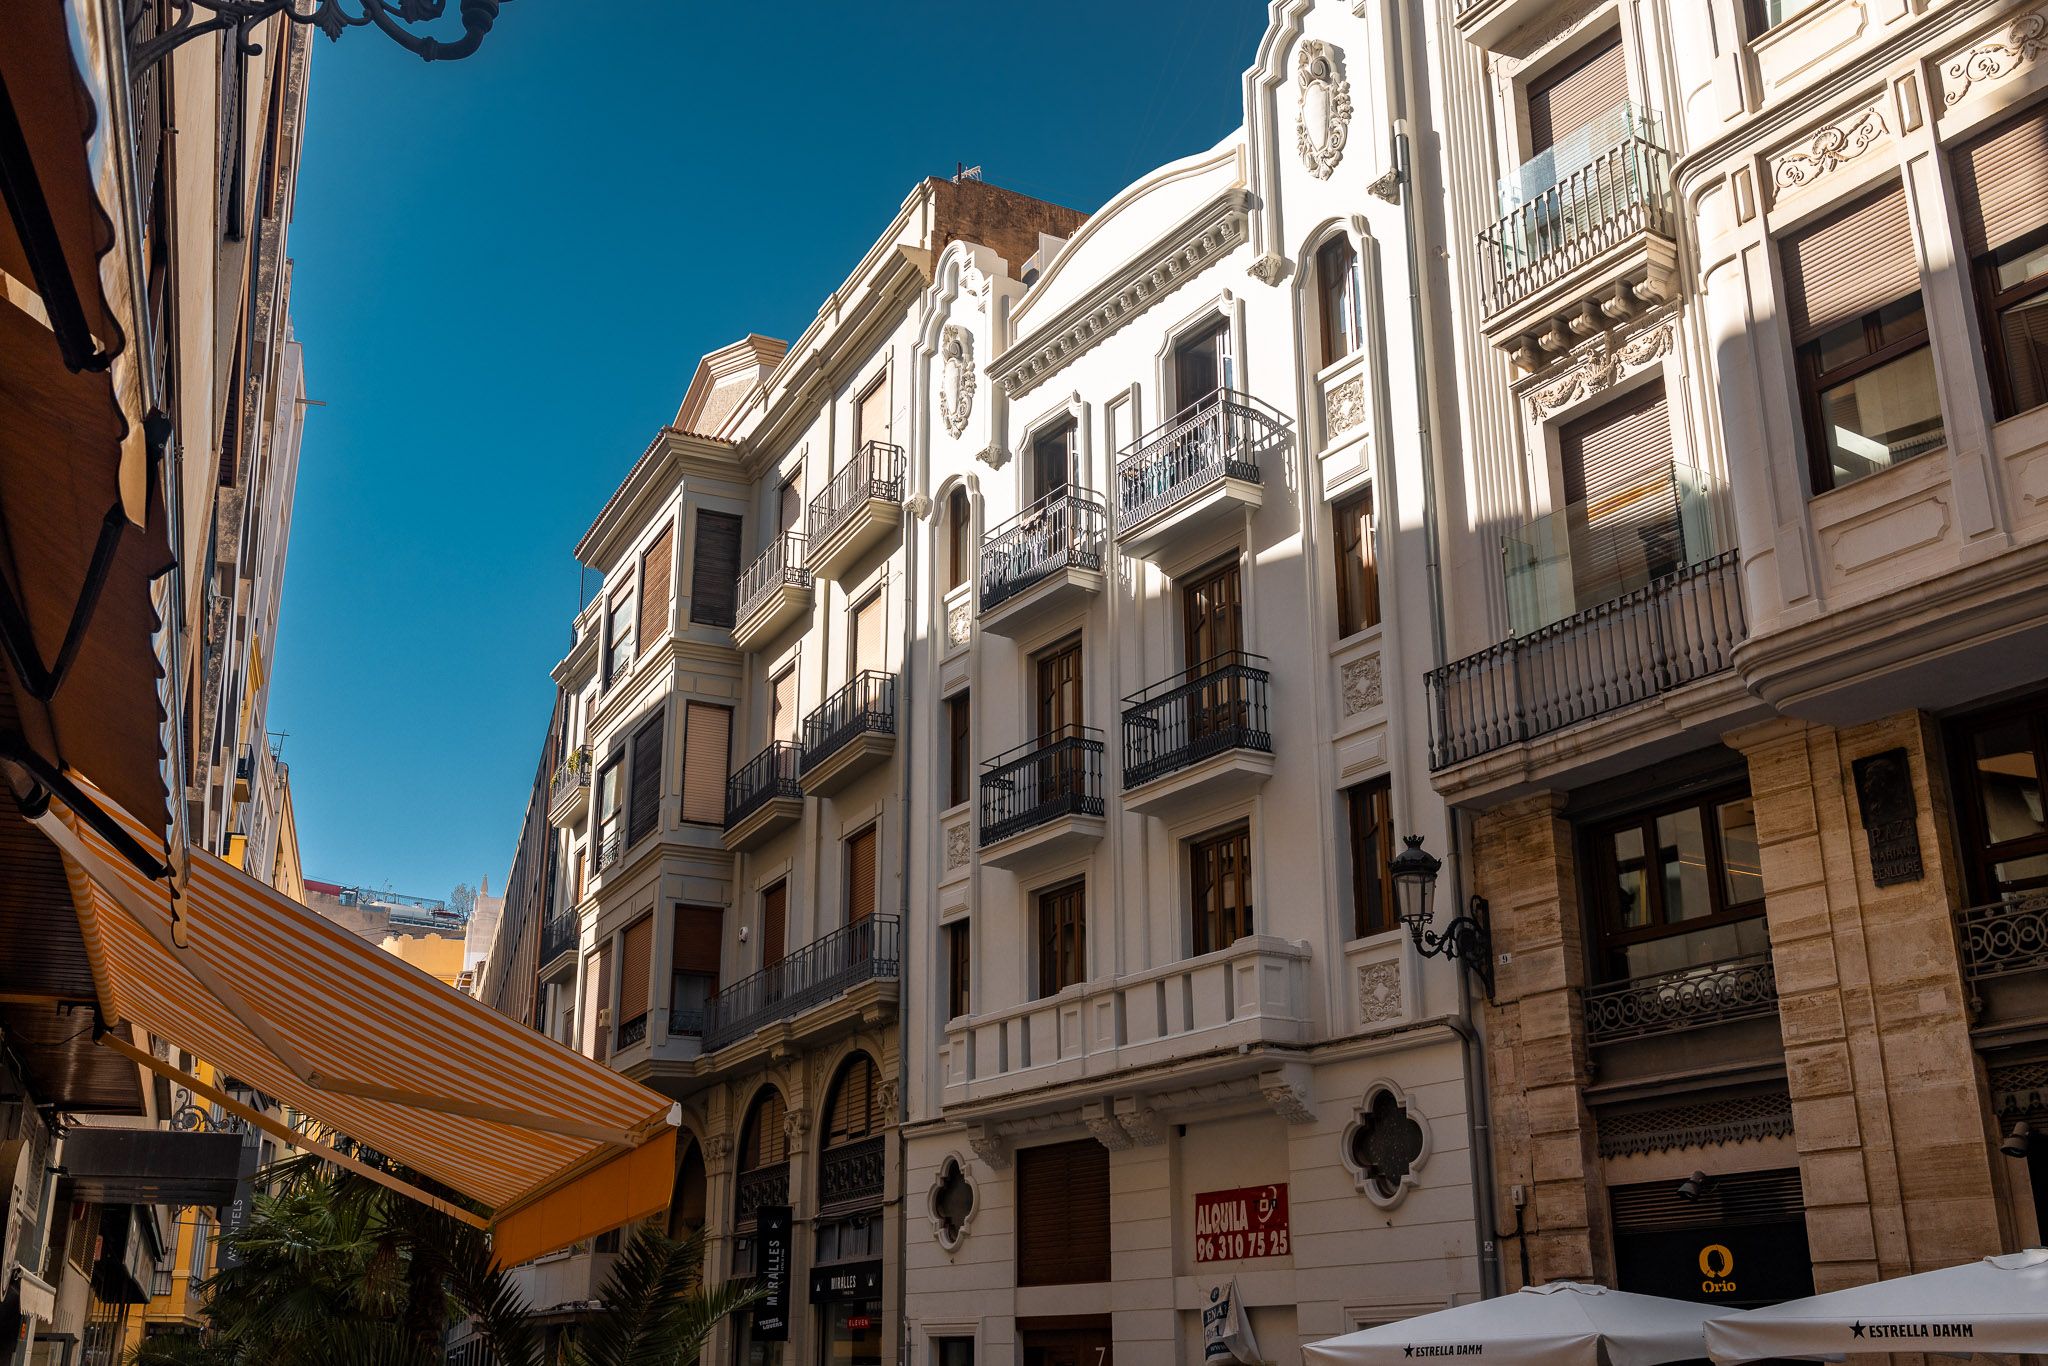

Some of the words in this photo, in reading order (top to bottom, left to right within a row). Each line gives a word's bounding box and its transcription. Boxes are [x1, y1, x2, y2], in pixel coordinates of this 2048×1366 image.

[1871, 819, 1913, 847] PLAZA
[1871, 846, 1919, 862] MARIANO
[1873, 861, 1920, 880] BENLLIURE
[1502, 955, 1508, 963] 9
[1197, 1200, 1249, 1235] ALQUILA
[1197, 1237, 1214, 1261] 96
[1218, 1233, 1244, 1259] 310
[1248, 1231, 1265, 1256] 75
[1270, 1229, 1288, 1255] 25
[766, 1240, 780, 1306] MIRALLES
[831, 1275, 857, 1290] MIRALLES
[1702, 1280, 1737, 1293] Orio
[759, 1318, 779, 1326] TRENDS
[762, 1321, 783, 1330] LOVERS
[848, 1318, 869, 1327] ELEVEN
[1869, 1324, 1929, 1338] ESTRELLA
[1933, 1323, 1974, 1337] DAMM
[1095, 1346, 1106, 1366] 7
[1416, 1345, 1454, 1357] ESTRELLA
[1457, 1344, 1483, 1355] DAMM
